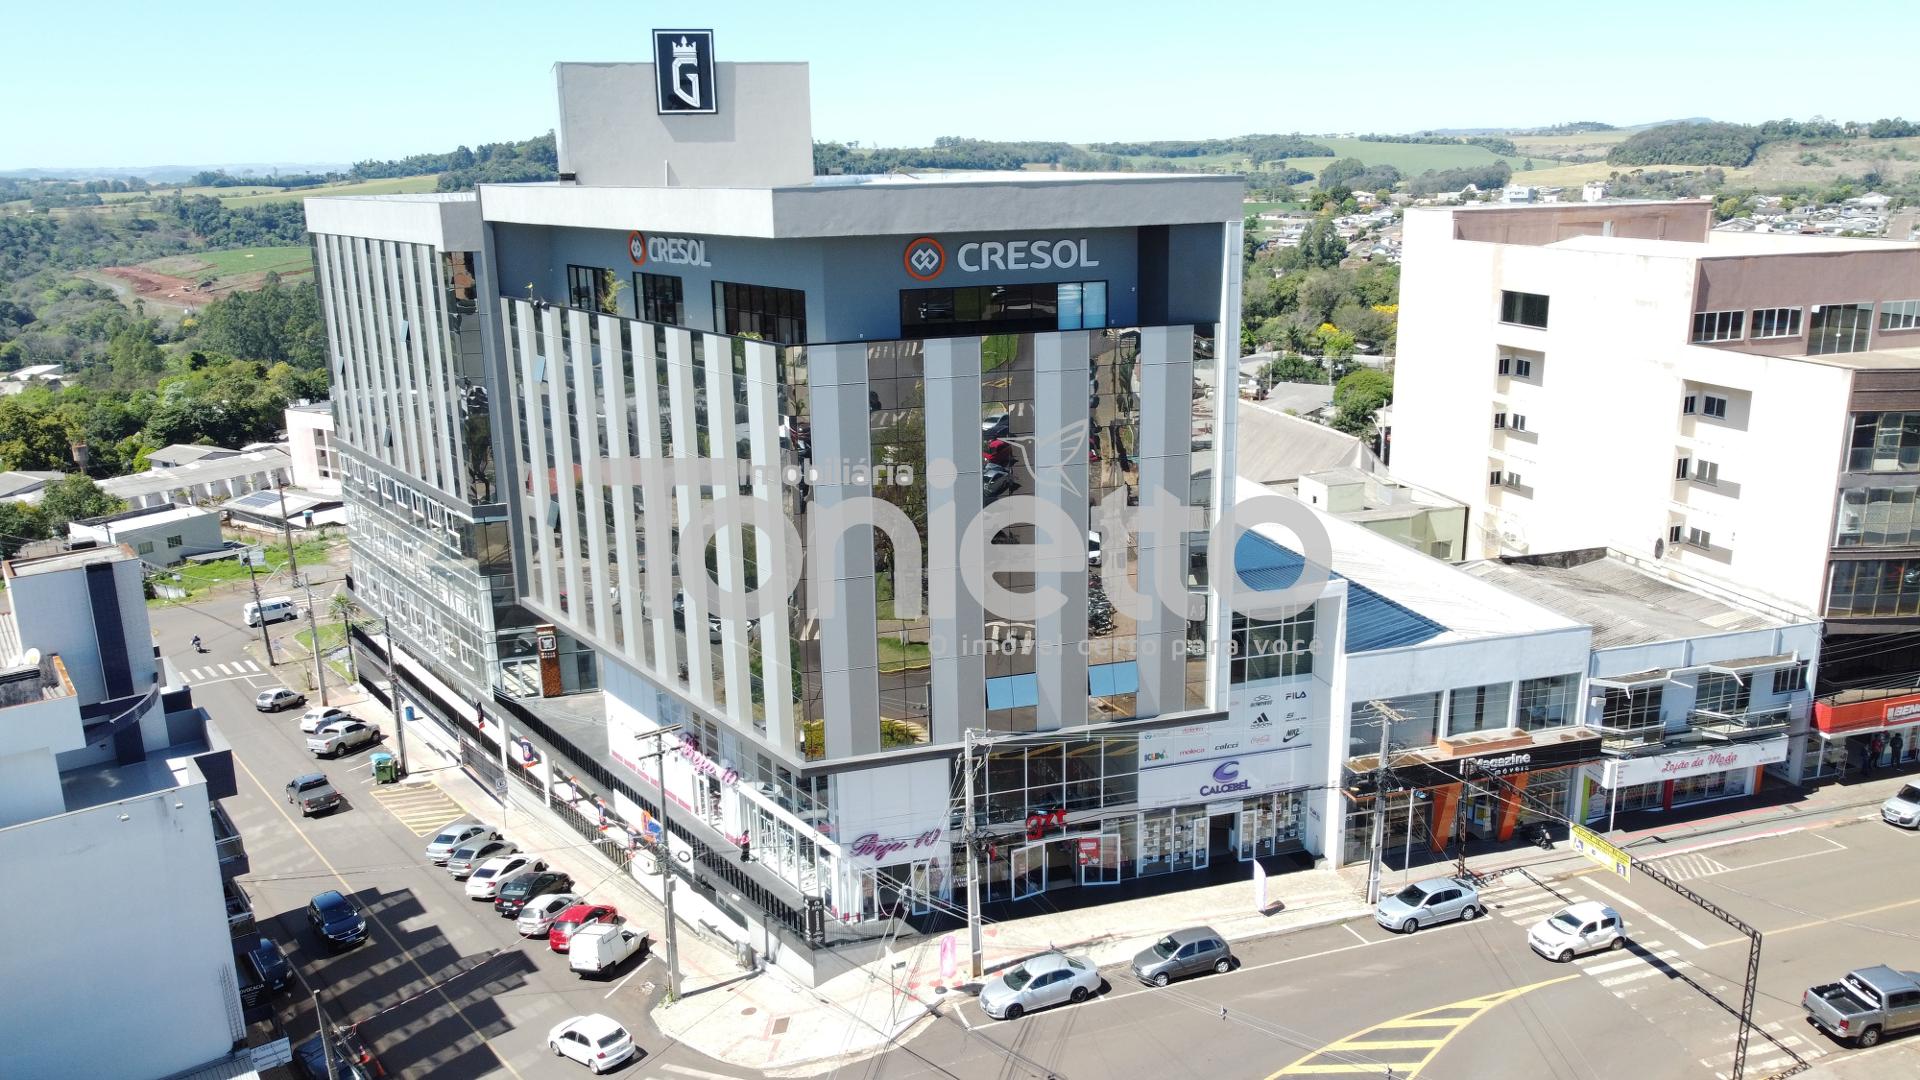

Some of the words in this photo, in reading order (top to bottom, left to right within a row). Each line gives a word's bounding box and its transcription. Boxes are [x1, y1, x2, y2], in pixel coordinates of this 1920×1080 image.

[648, 237, 711, 266] CRESOL
[957, 239, 1100, 272] CRESOL
[1285, 691, 1307, 700] FILA
[1286, 728, 1301, 736] NIKE
